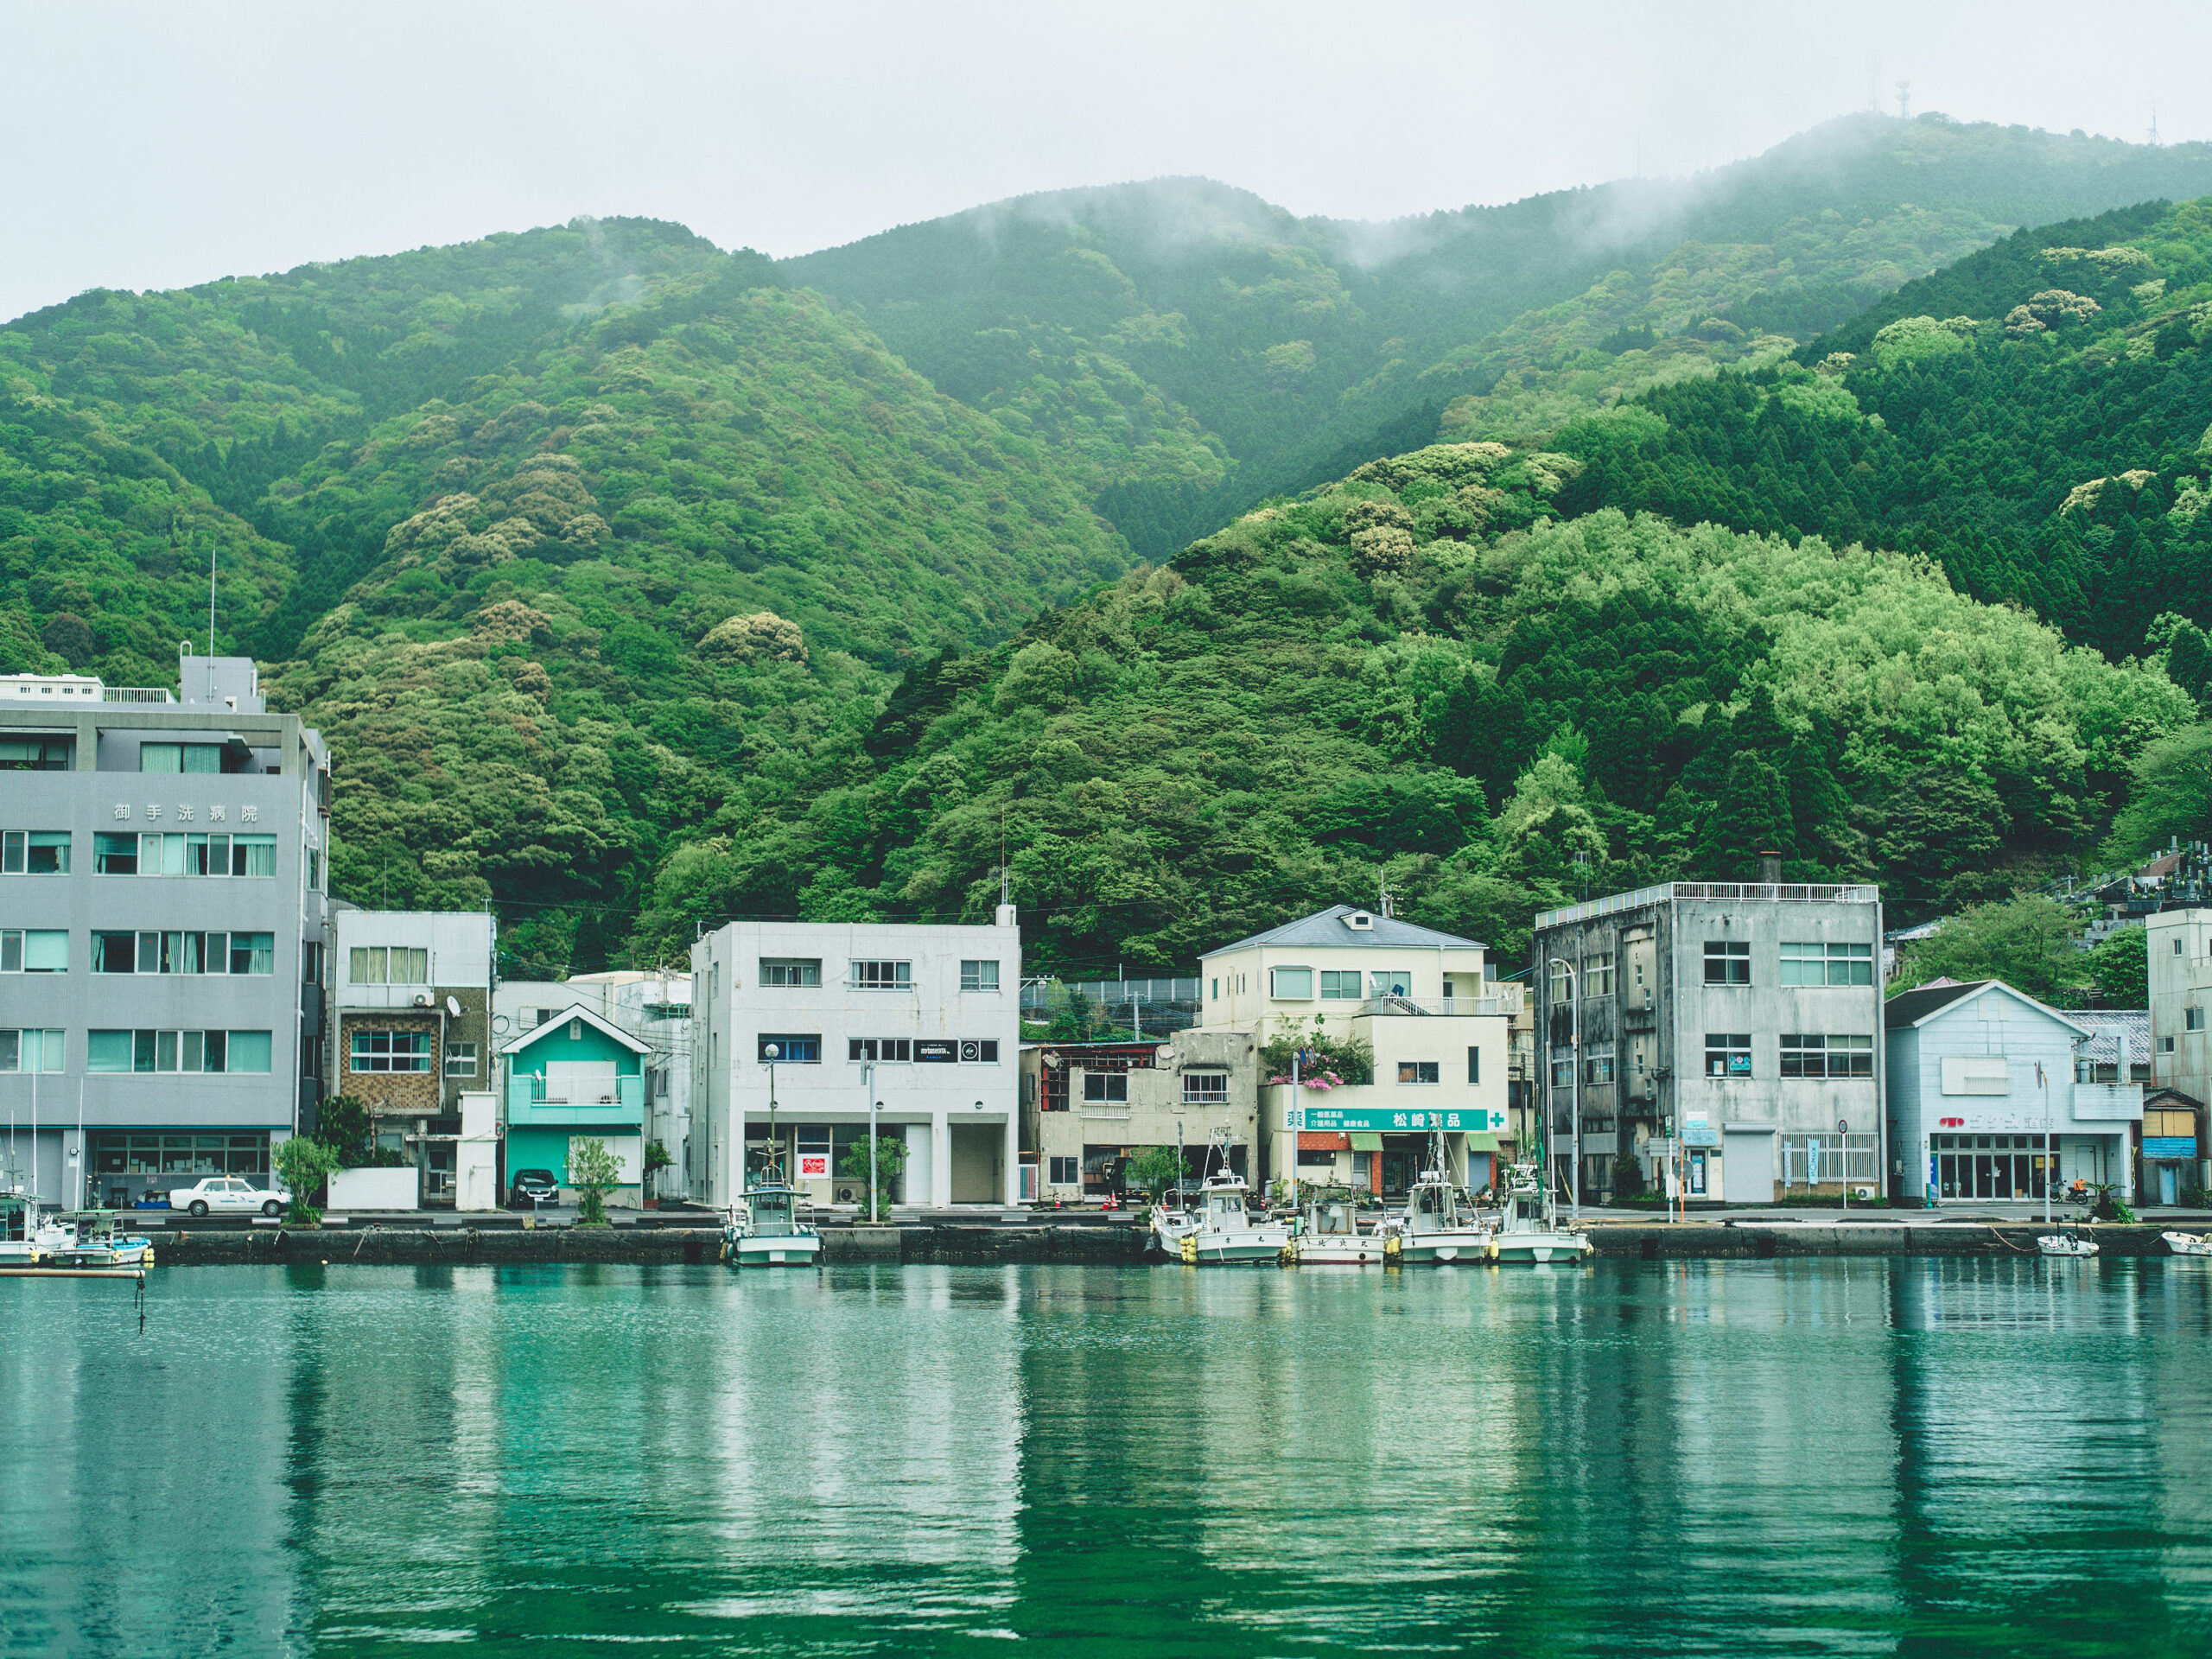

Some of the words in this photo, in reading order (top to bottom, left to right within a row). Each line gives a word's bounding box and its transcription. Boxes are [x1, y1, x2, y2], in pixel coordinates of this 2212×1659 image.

[114, 804, 257, 822] 御手洗病院
